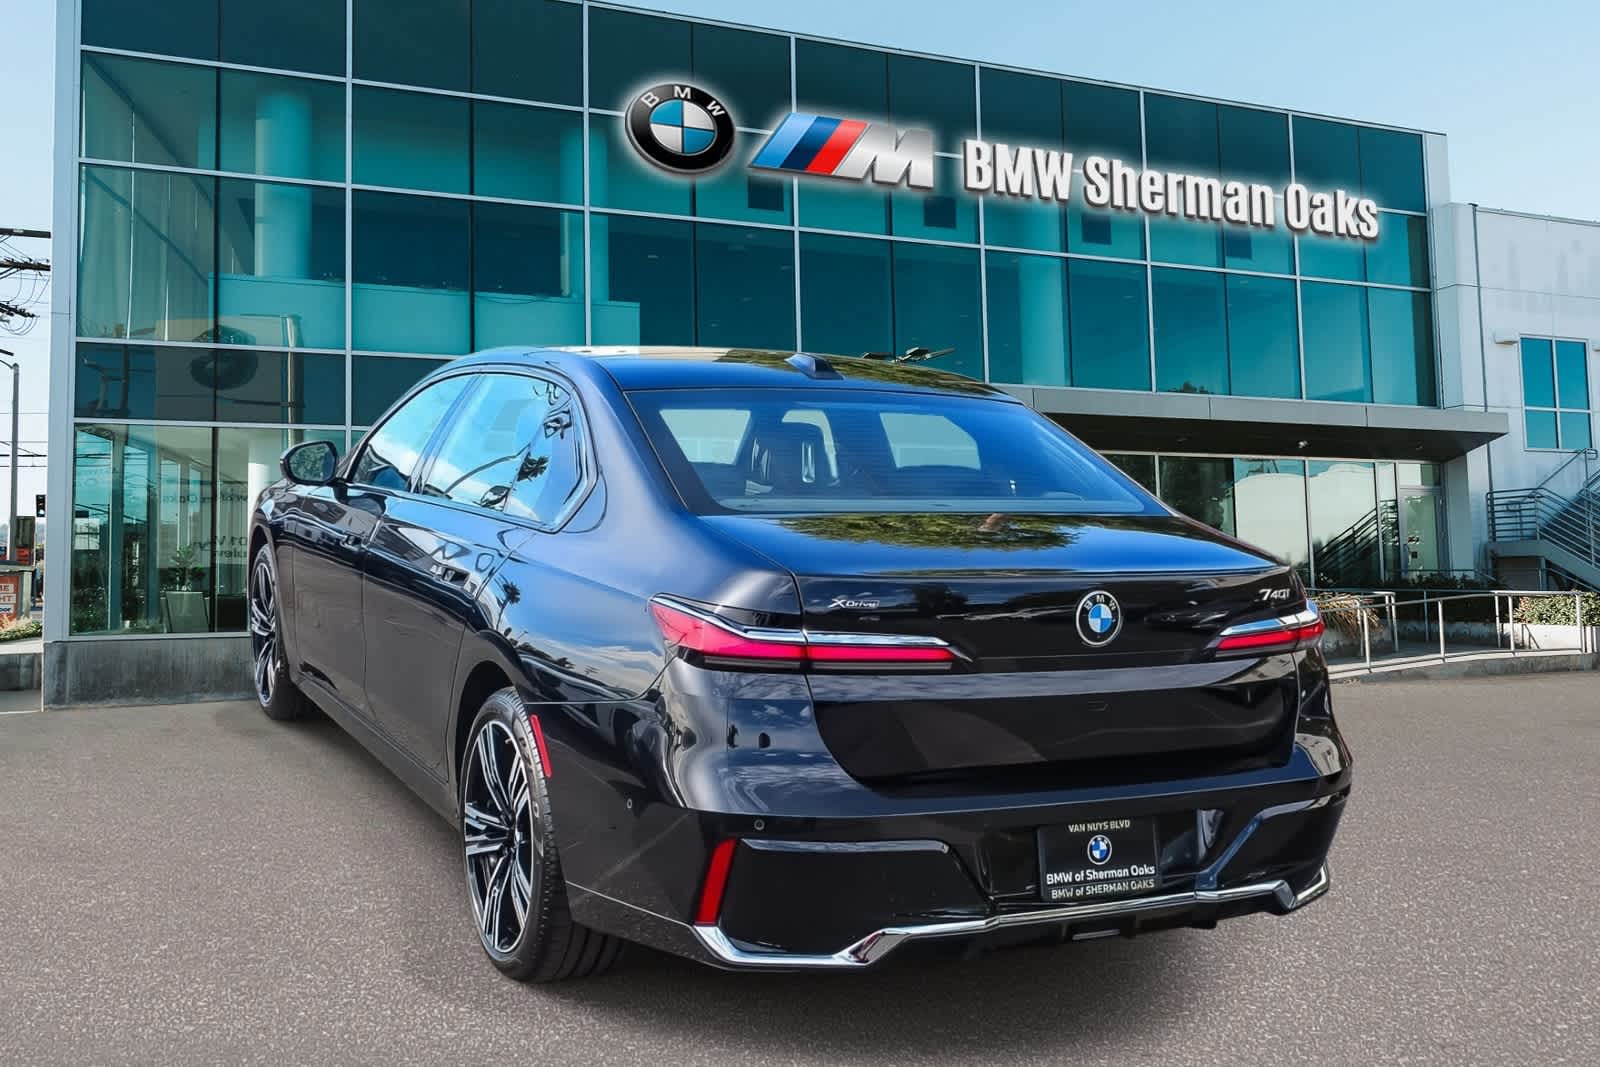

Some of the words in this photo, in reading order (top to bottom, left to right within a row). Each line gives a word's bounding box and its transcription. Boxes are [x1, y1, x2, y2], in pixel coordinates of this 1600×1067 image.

[640, 85, 725, 117] BMW
[963, 139, 1073, 202] BMW
[1083, 155, 1274, 227] Sherman
[1284, 183, 1379, 240] Oaks
[1083, 594, 1117, 611] BMW
[1068, 823, 1085, 833] VAN
[1087, 821, 1109, 831] NUYS
[1110, 819, 1130, 830] BLVD
[1046, 871, 1073, 885] BMW
[1075, 870, 1084, 882] of
[1086, 868, 1129, 880] Sherman
[1131, 864, 1155, 876] Oaks
[1052, 888, 1074, 899] BMW
[1075, 887, 1084, 896] of
[1086, 883, 1128, 895] SHERMAN
[1131, 879, 1154, 889] OAKS
